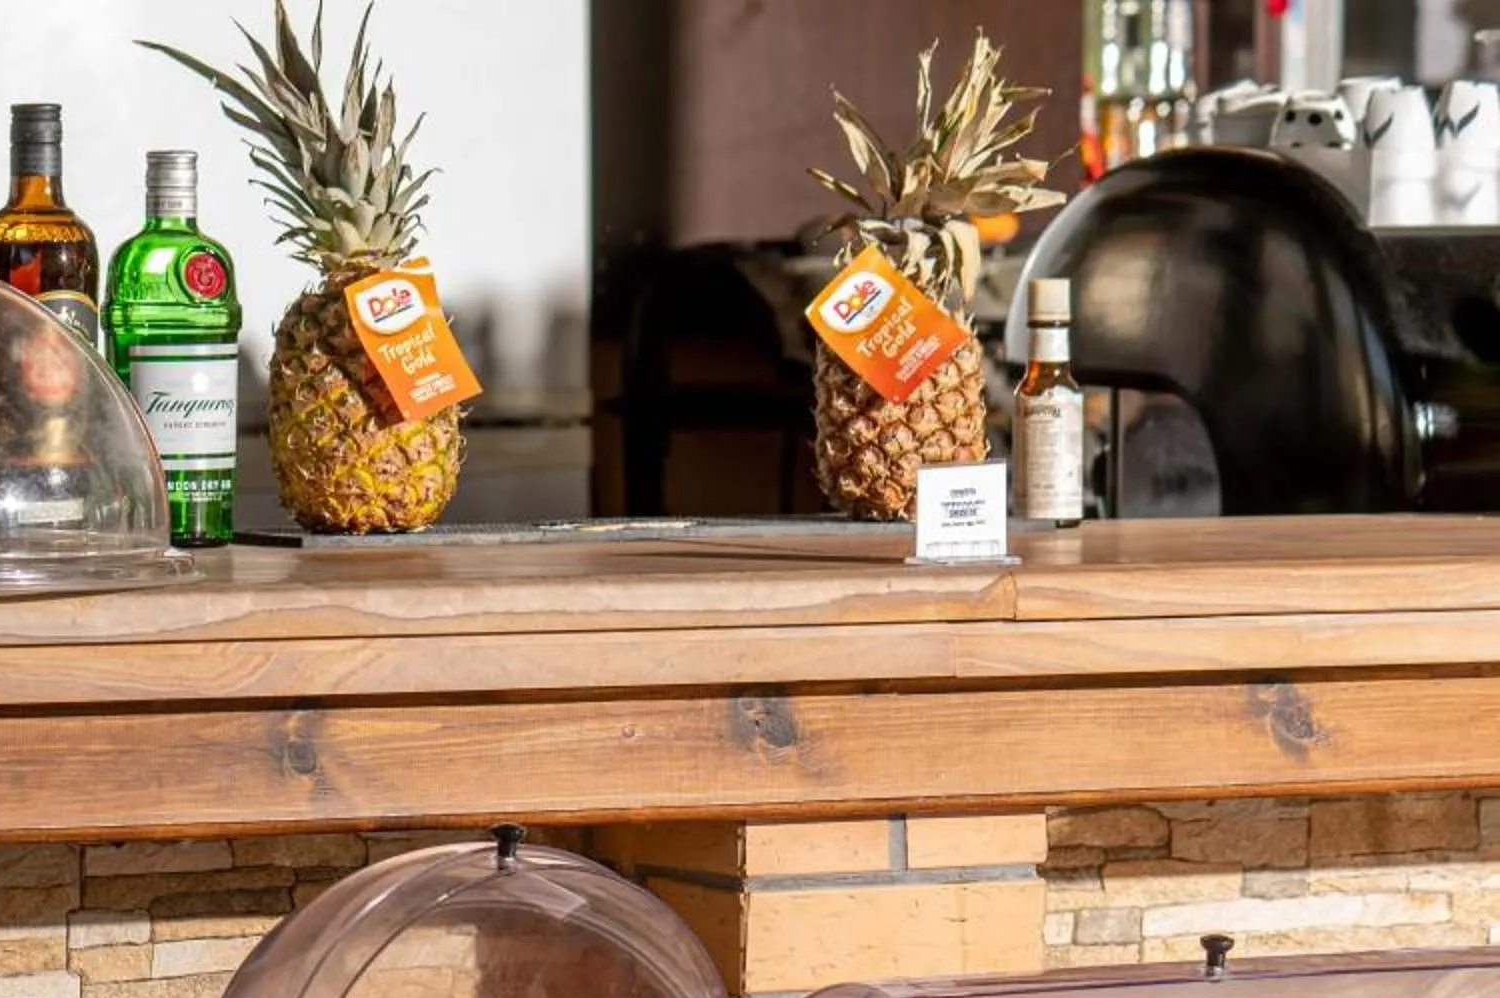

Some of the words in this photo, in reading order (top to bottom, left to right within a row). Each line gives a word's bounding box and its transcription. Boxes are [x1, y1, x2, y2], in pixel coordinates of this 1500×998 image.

[367, 287, 412, 318] Dole
[833, 280, 878, 321] Dole
[377, 321, 437, 363] Tropical
[856, 295, 913, 358] Tropical
[881, 320, 917, 358] Gold
[167, 480, 197, 491] NDON
